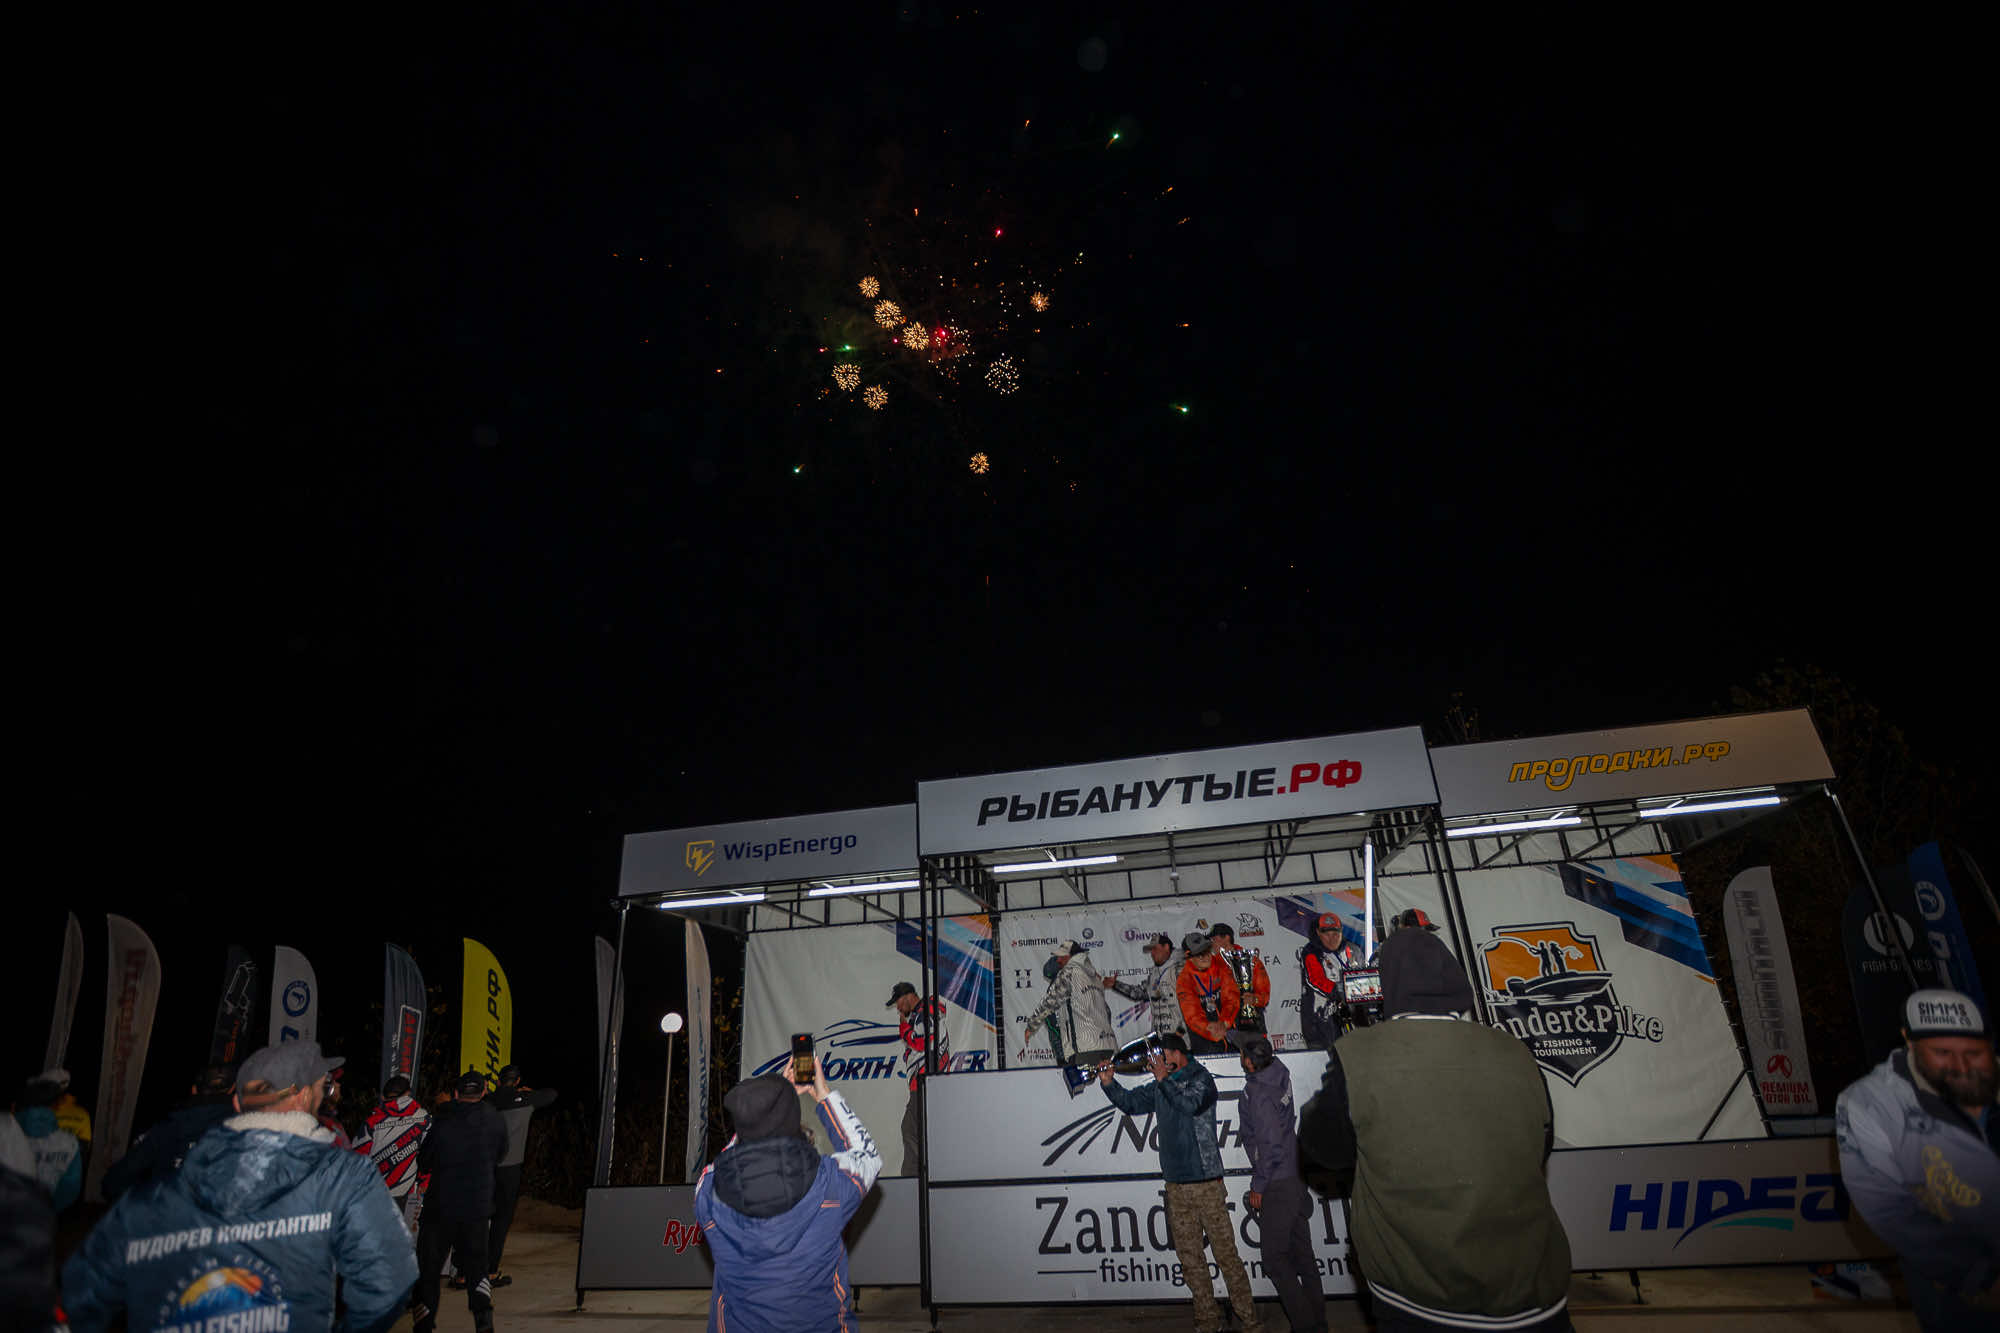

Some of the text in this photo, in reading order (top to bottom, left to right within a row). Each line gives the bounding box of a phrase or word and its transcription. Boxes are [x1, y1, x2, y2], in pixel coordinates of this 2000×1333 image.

[977, 760, 1362, 826] РЫБАНУТЫЕ.РФ
[724, 834, 858, 861] WispEnergo
[1492, 1004, 1664, 1042] nder&Pike
[1534, 1046, 1598, 1057] TOURNAMENT
[1543, 1038, 1583, 1048] FISHING
[126, 1211, 332, 1265] ДУДОРЕВ КОНСТАНТИН
[1100, 1257, 1186, 1287] fishing
